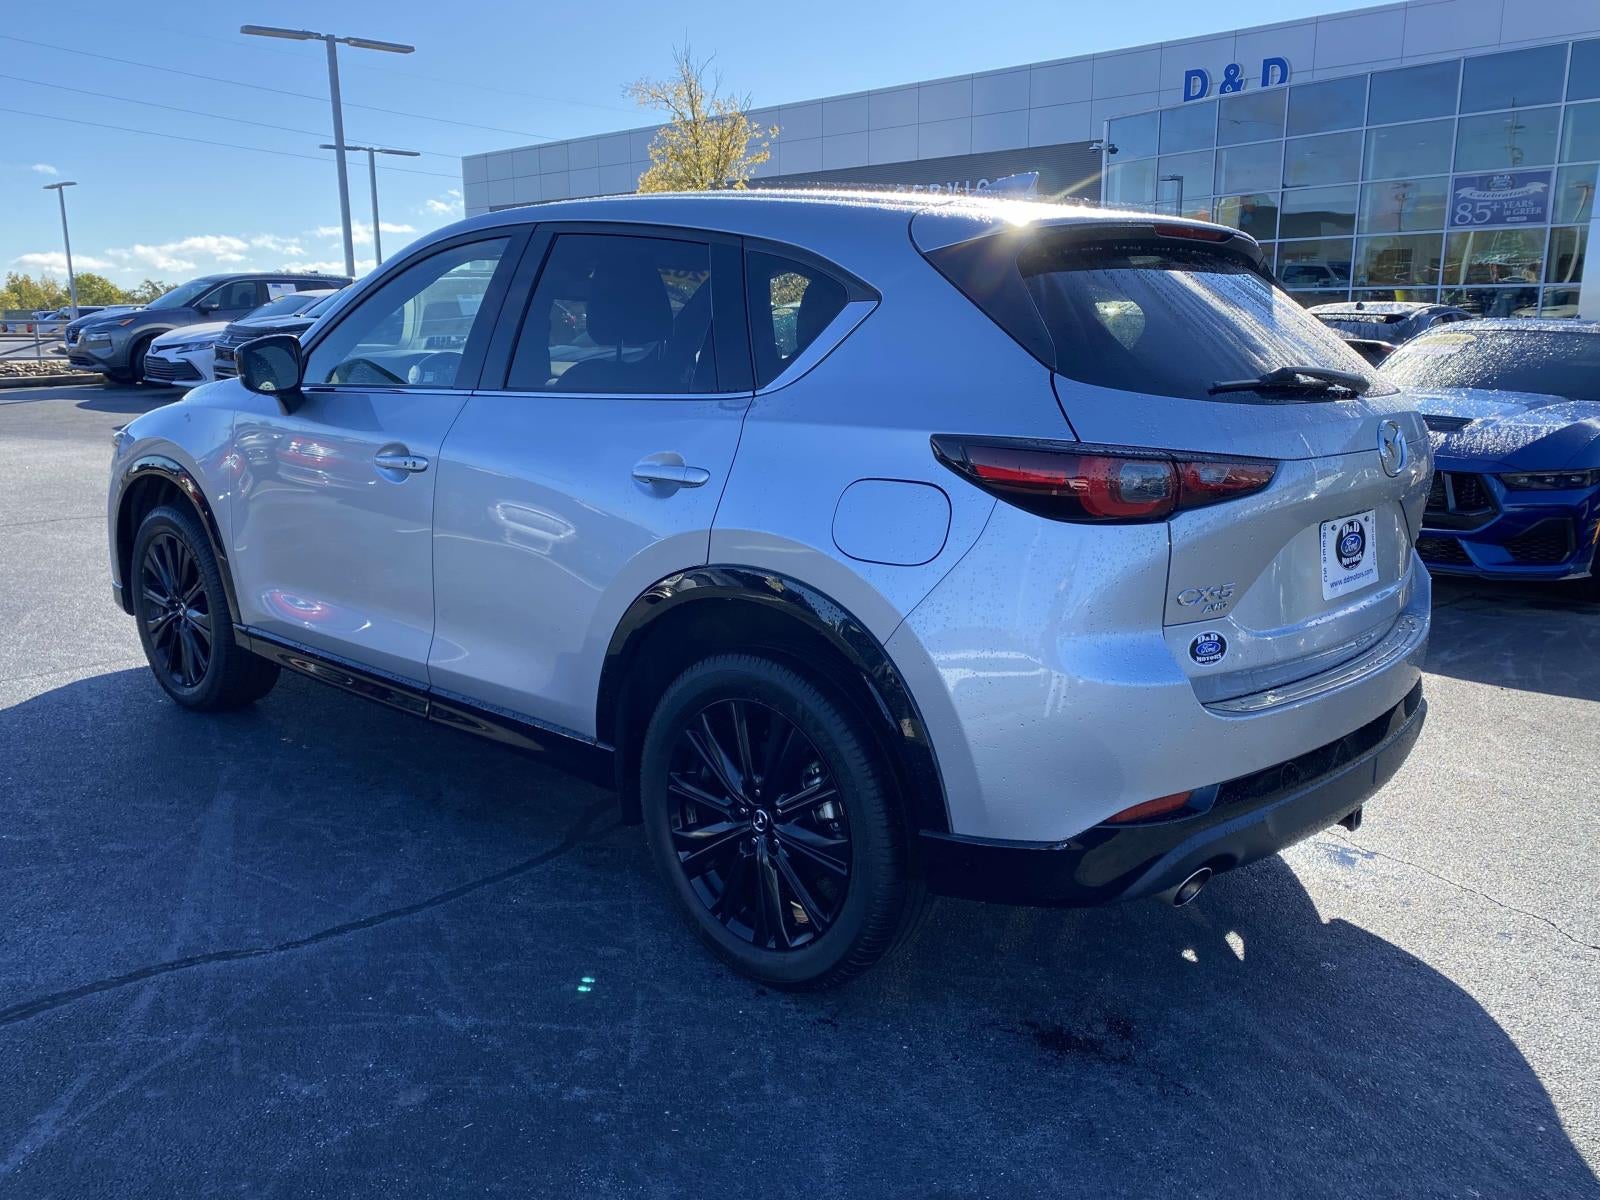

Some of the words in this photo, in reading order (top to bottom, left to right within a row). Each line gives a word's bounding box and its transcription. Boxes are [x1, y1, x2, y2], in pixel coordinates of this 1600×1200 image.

[1183, 69, 1209, 102] D
[1219, 63, 1244, 94] &
[1261, 57, 1289, 87] D
[1503, 200, 1534, 209] YEARS
[1514, 206, 1542, 216] GREER
[1454, 201, 1500, 225] 85+
[1342, 521, 1360, 537] D&D
[1177, 583, 1236, 606] CX-5
[1197, 633, 1219, 644] D&D
[1196, 652, 1222, 662] MOTORS
